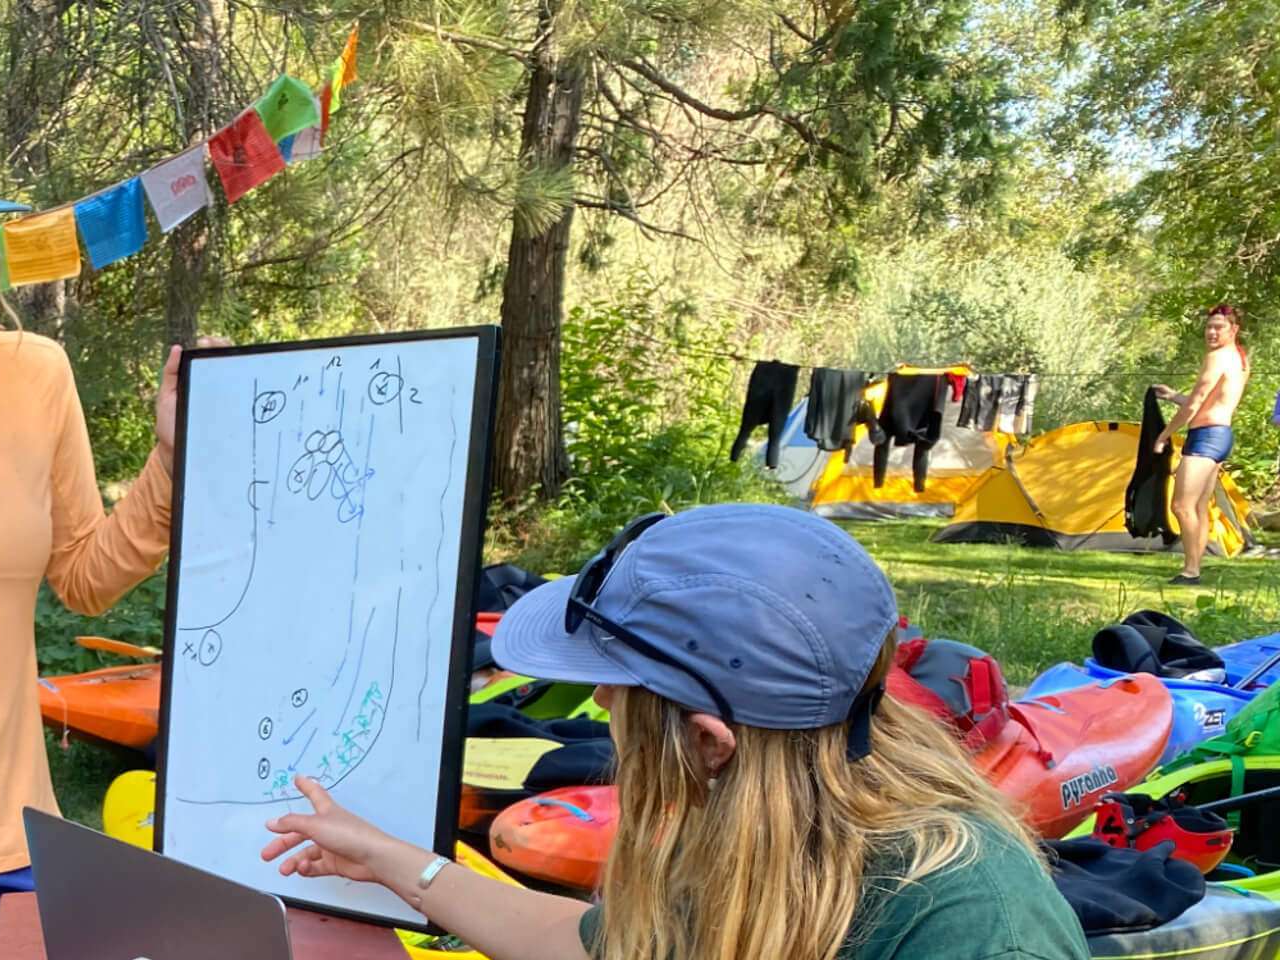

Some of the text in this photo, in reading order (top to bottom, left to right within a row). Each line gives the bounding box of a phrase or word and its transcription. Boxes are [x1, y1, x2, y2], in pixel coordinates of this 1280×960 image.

[326, 356, 343, 370] 12
[409, 387, 423, 405] 2
[1204, 709, 1226, 726] ZET
